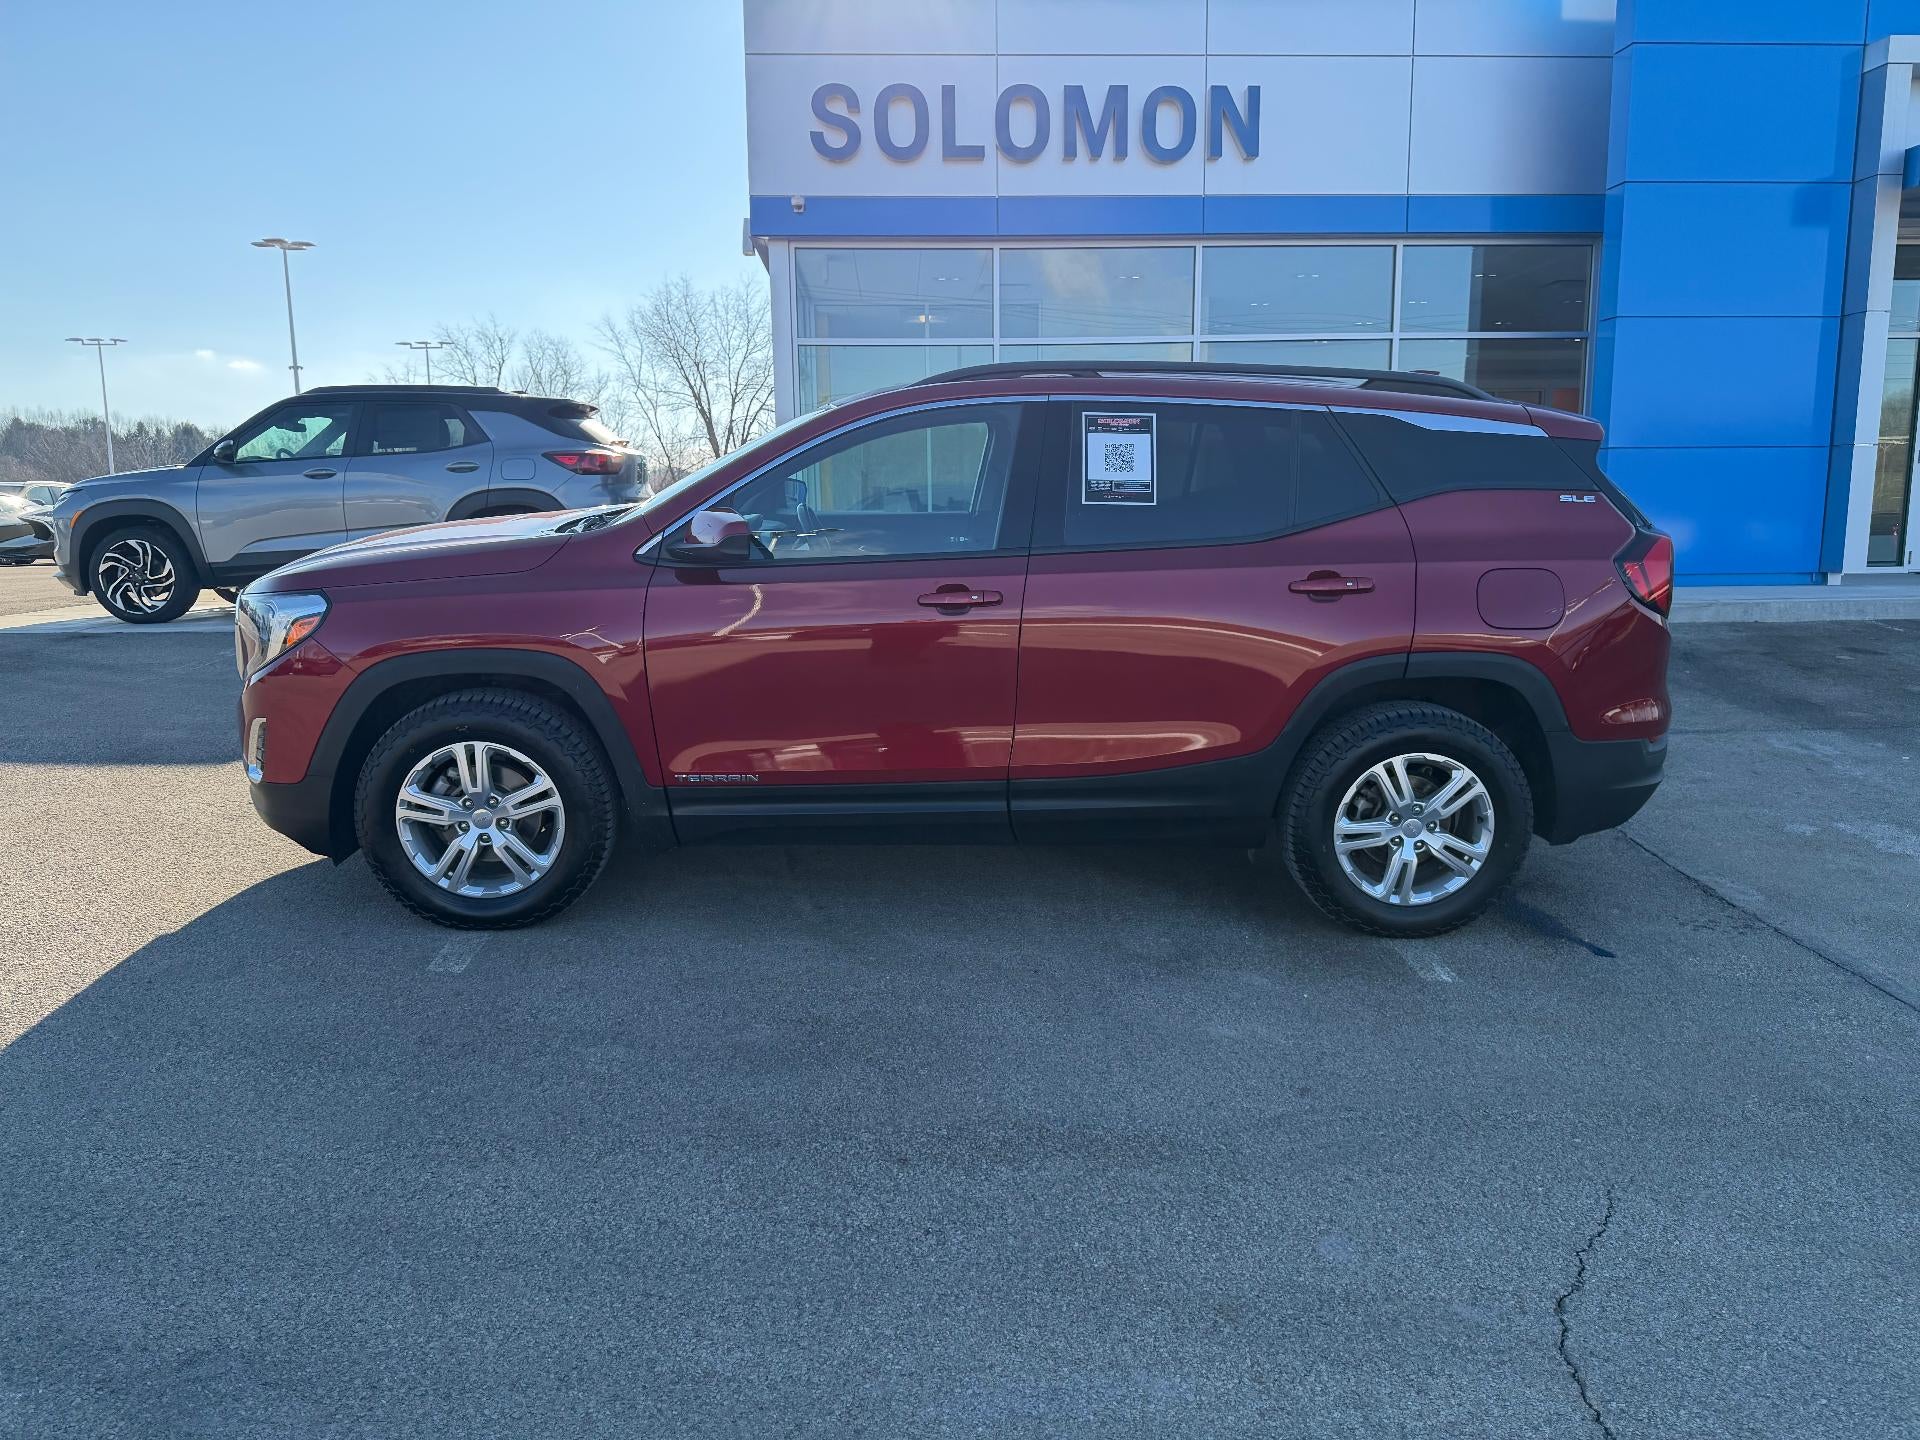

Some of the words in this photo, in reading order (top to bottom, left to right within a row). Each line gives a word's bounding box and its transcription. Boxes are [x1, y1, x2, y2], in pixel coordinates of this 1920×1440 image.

[810, 82, 1261, 163] SOLOMON
[1559, 494, 1596, 503] SLE
[674, 774, 760, 783] TERRAIN
